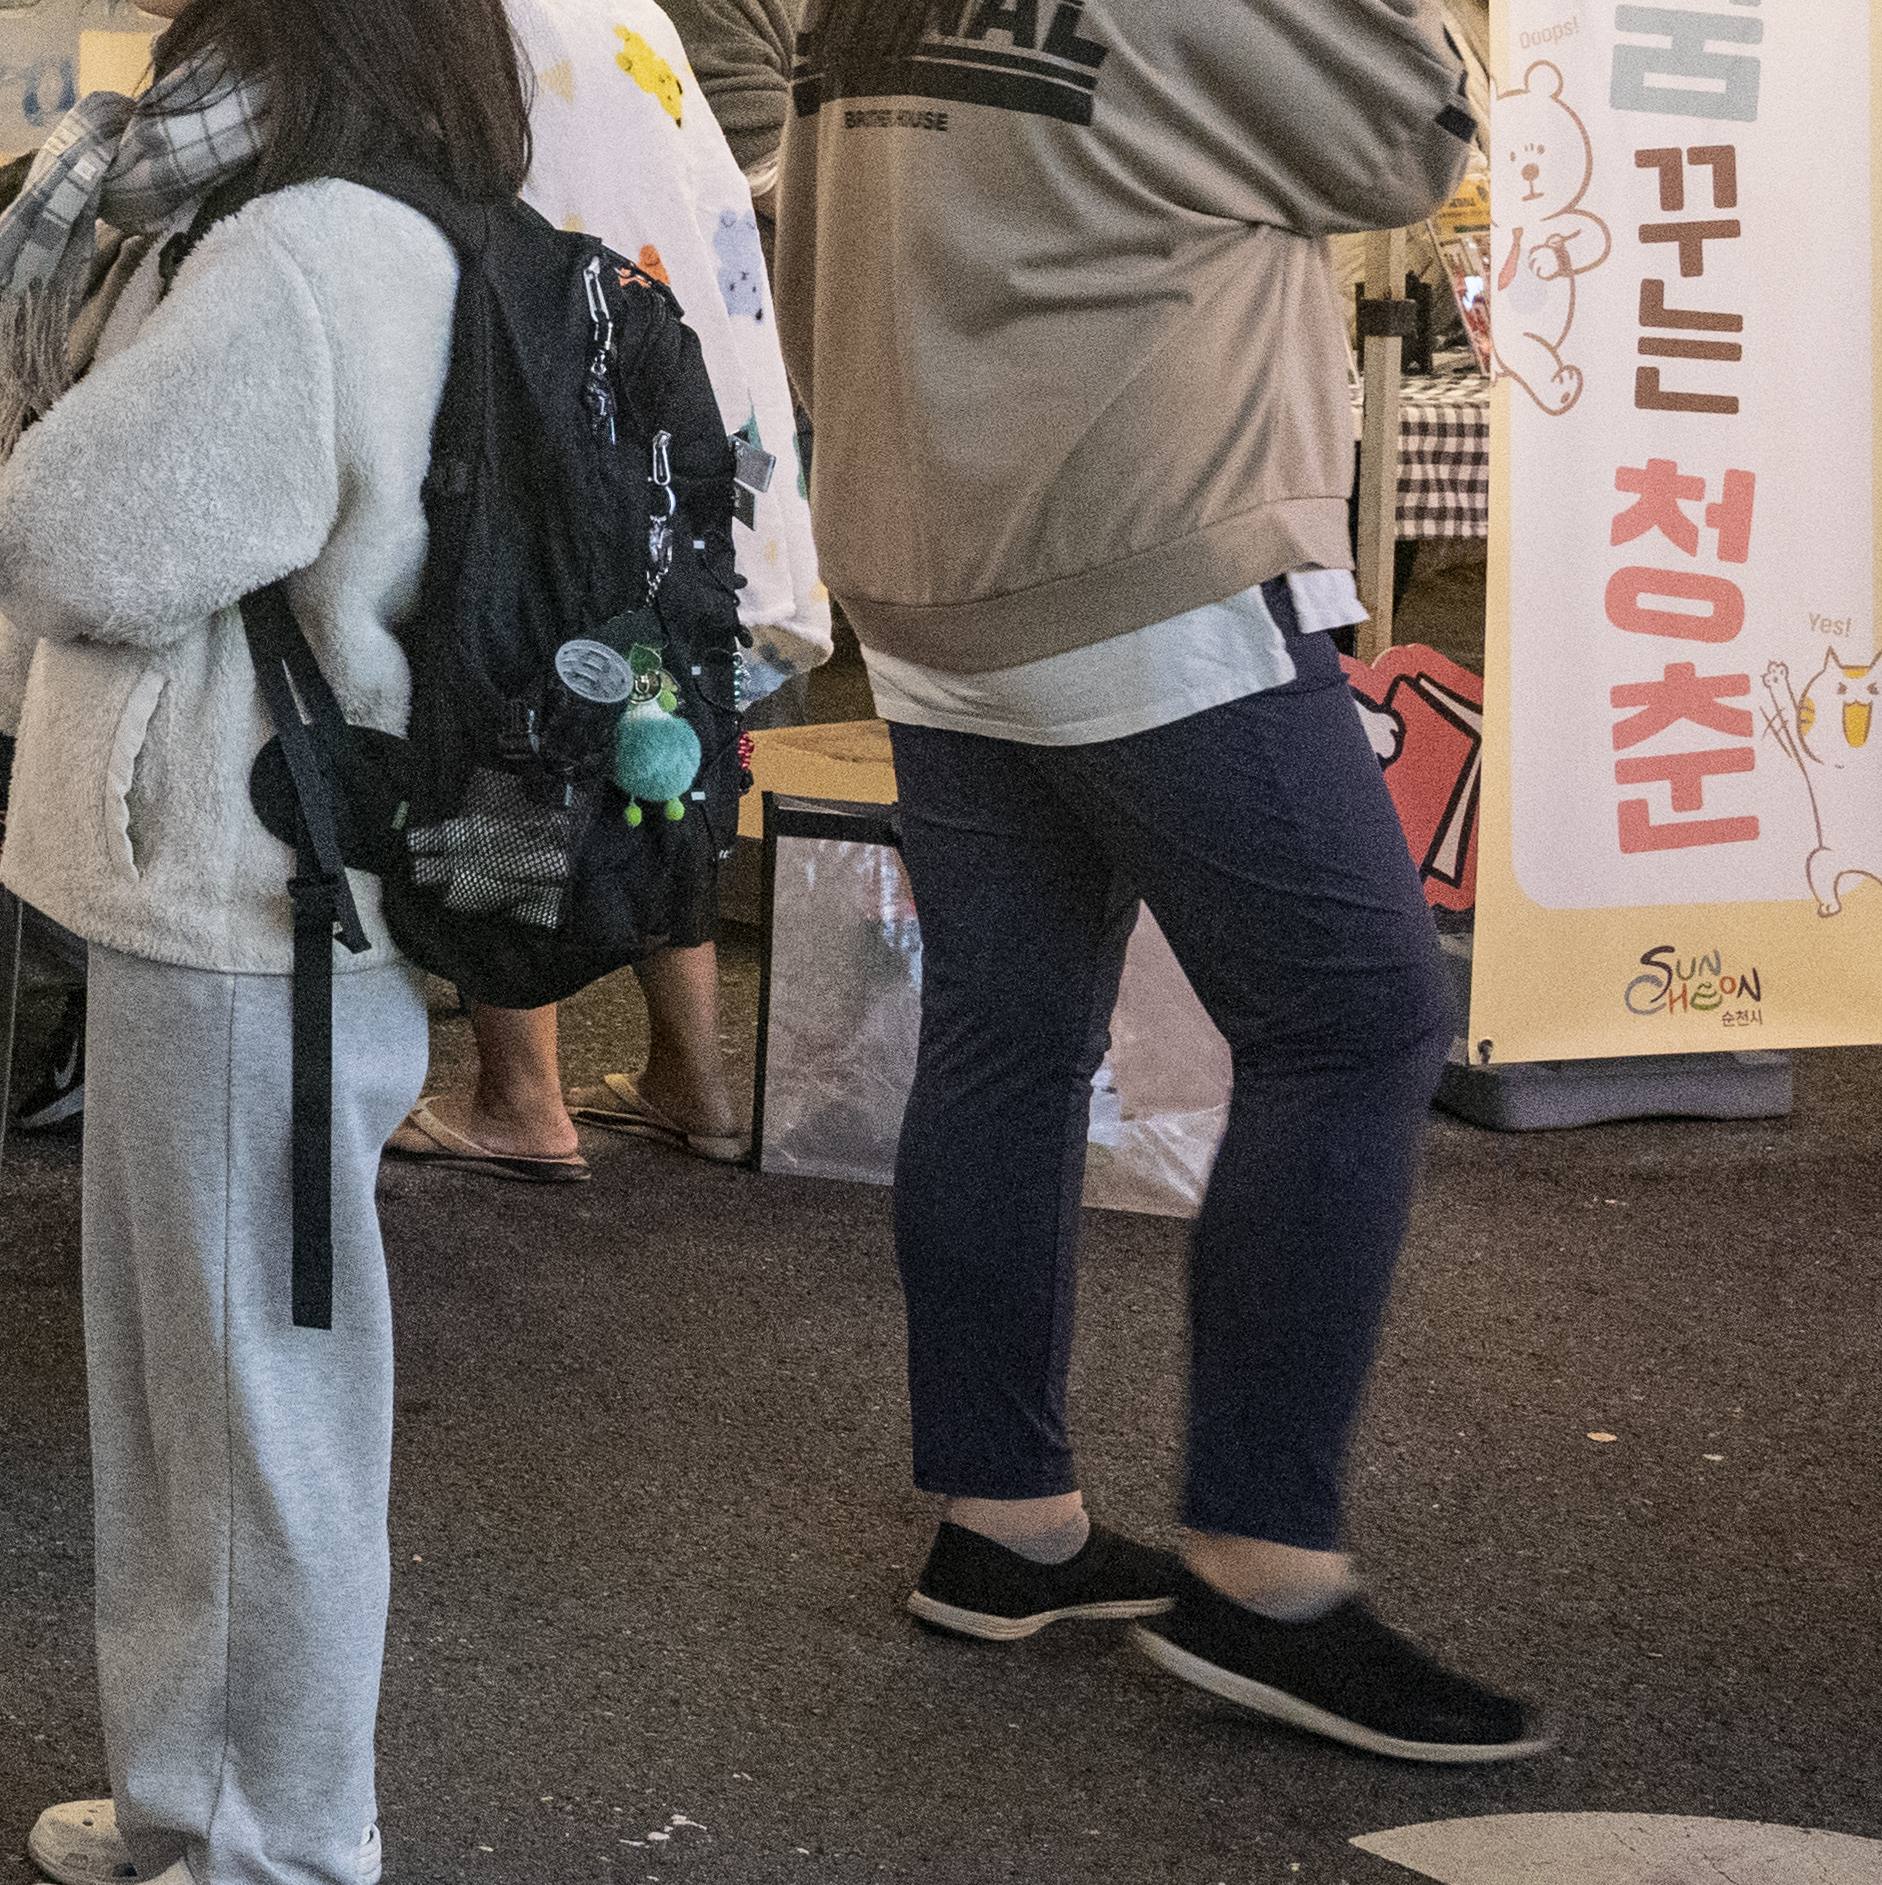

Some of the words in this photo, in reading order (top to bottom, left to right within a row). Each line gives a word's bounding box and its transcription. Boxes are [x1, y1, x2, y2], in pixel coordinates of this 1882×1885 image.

[1808, 612, 1852, 637] Yes!
[1604, 457, 1760, 854] 청춘
[1721, 1009, 1763, 1027] 순천시
